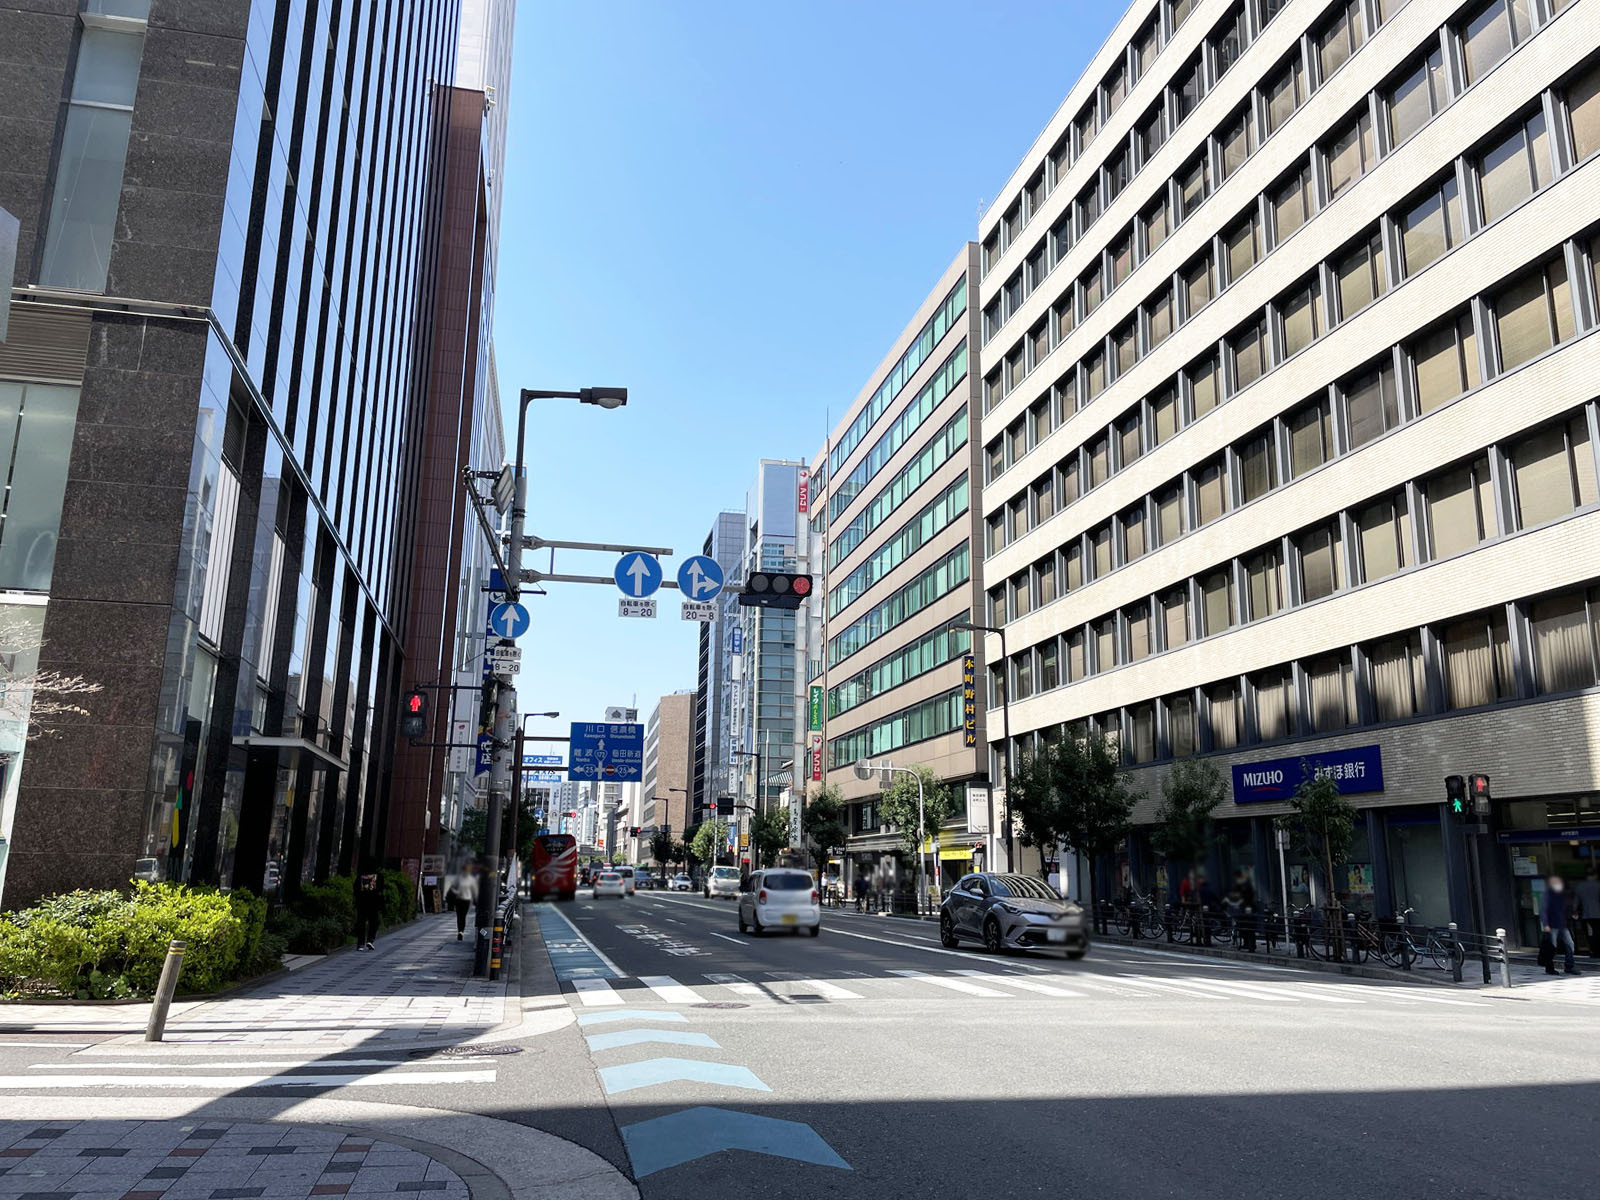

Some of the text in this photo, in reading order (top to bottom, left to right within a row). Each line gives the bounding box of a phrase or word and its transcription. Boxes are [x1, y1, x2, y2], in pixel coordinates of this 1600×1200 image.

[683, 603, 717, 611] 自転車を除く
[964, 658, 976, 745] 本町野村ビル
[585, 725, 605, 733] 川口
[1243, 769, 1284, 788] MIZUHO
[1313, 761, 1366, 782] みずほ銀行
